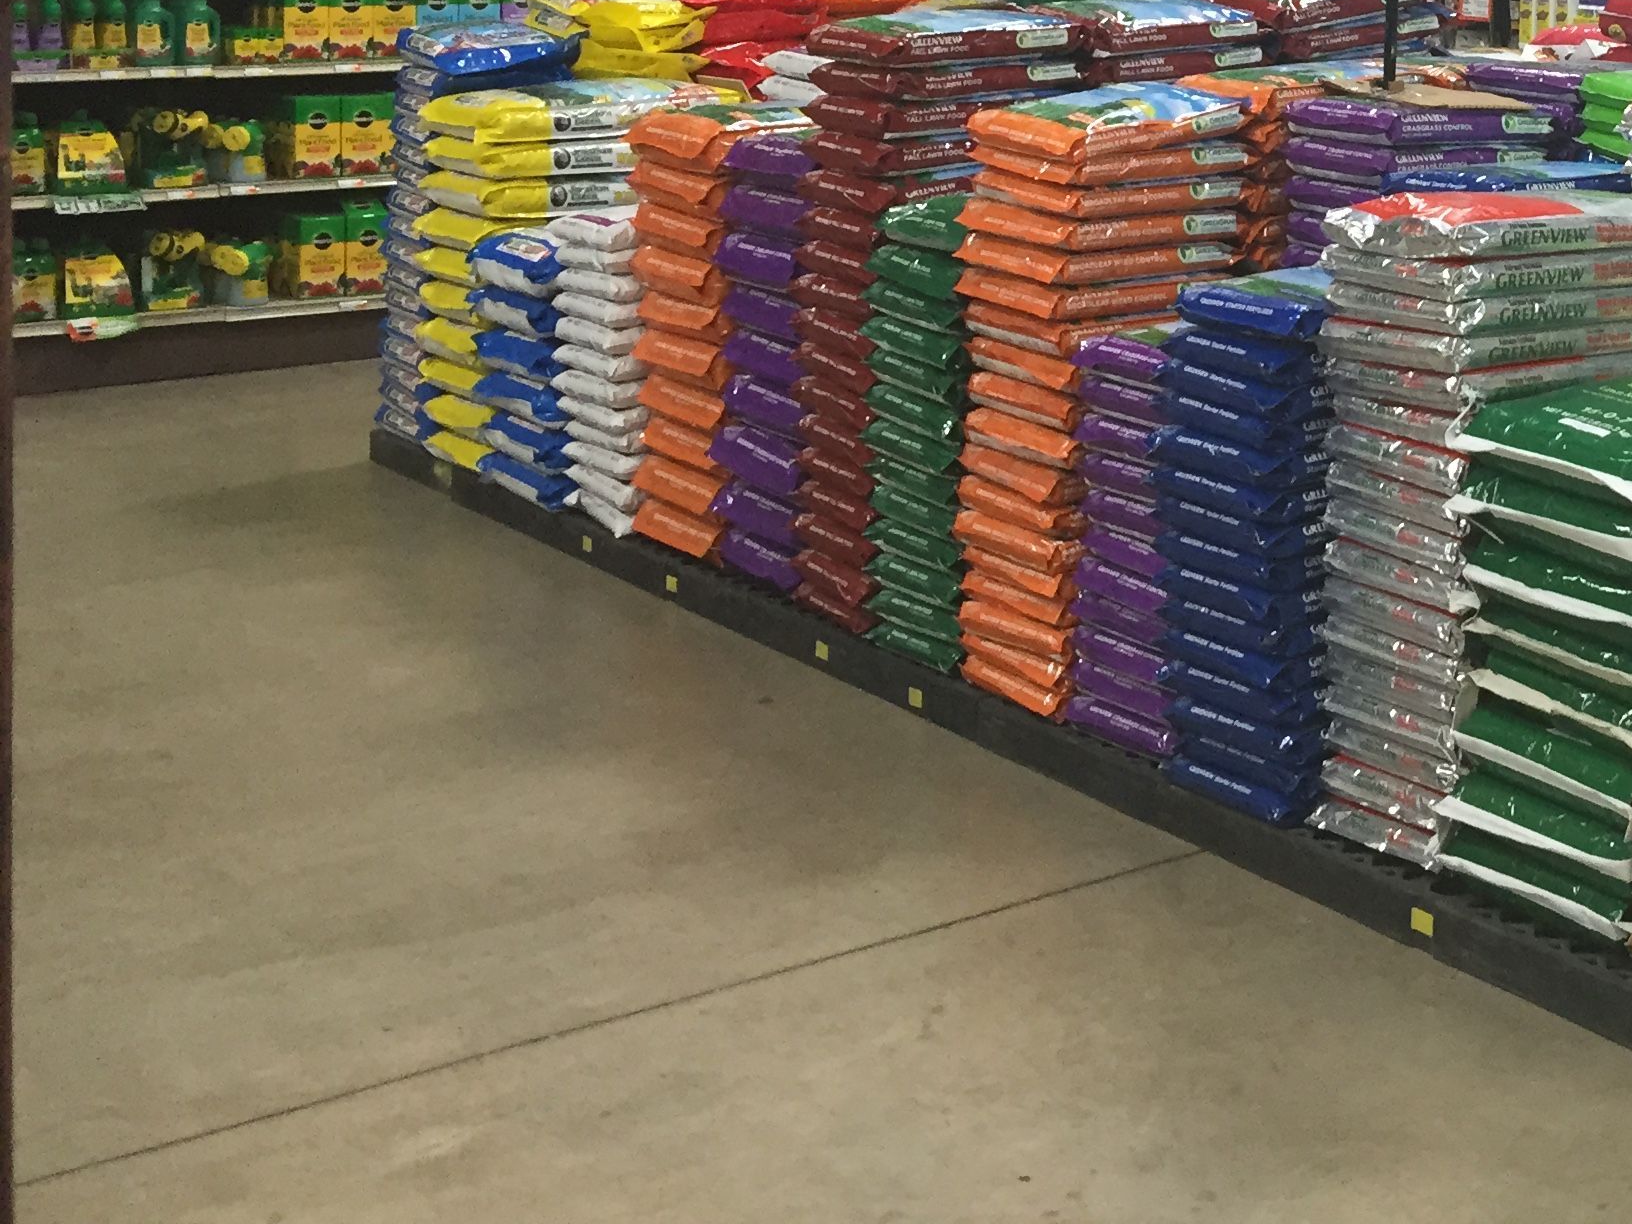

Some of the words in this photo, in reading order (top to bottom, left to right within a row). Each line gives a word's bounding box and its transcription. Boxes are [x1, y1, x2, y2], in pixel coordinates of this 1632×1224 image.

[1501, 226, 1590, 247] GREENVIEW
[1496, 266, 1585, 289] GREENVIEW
[1500, 303, 1588, 325] GREENVIEW
[1488, 340, 1579, 363] GREENVIEW
